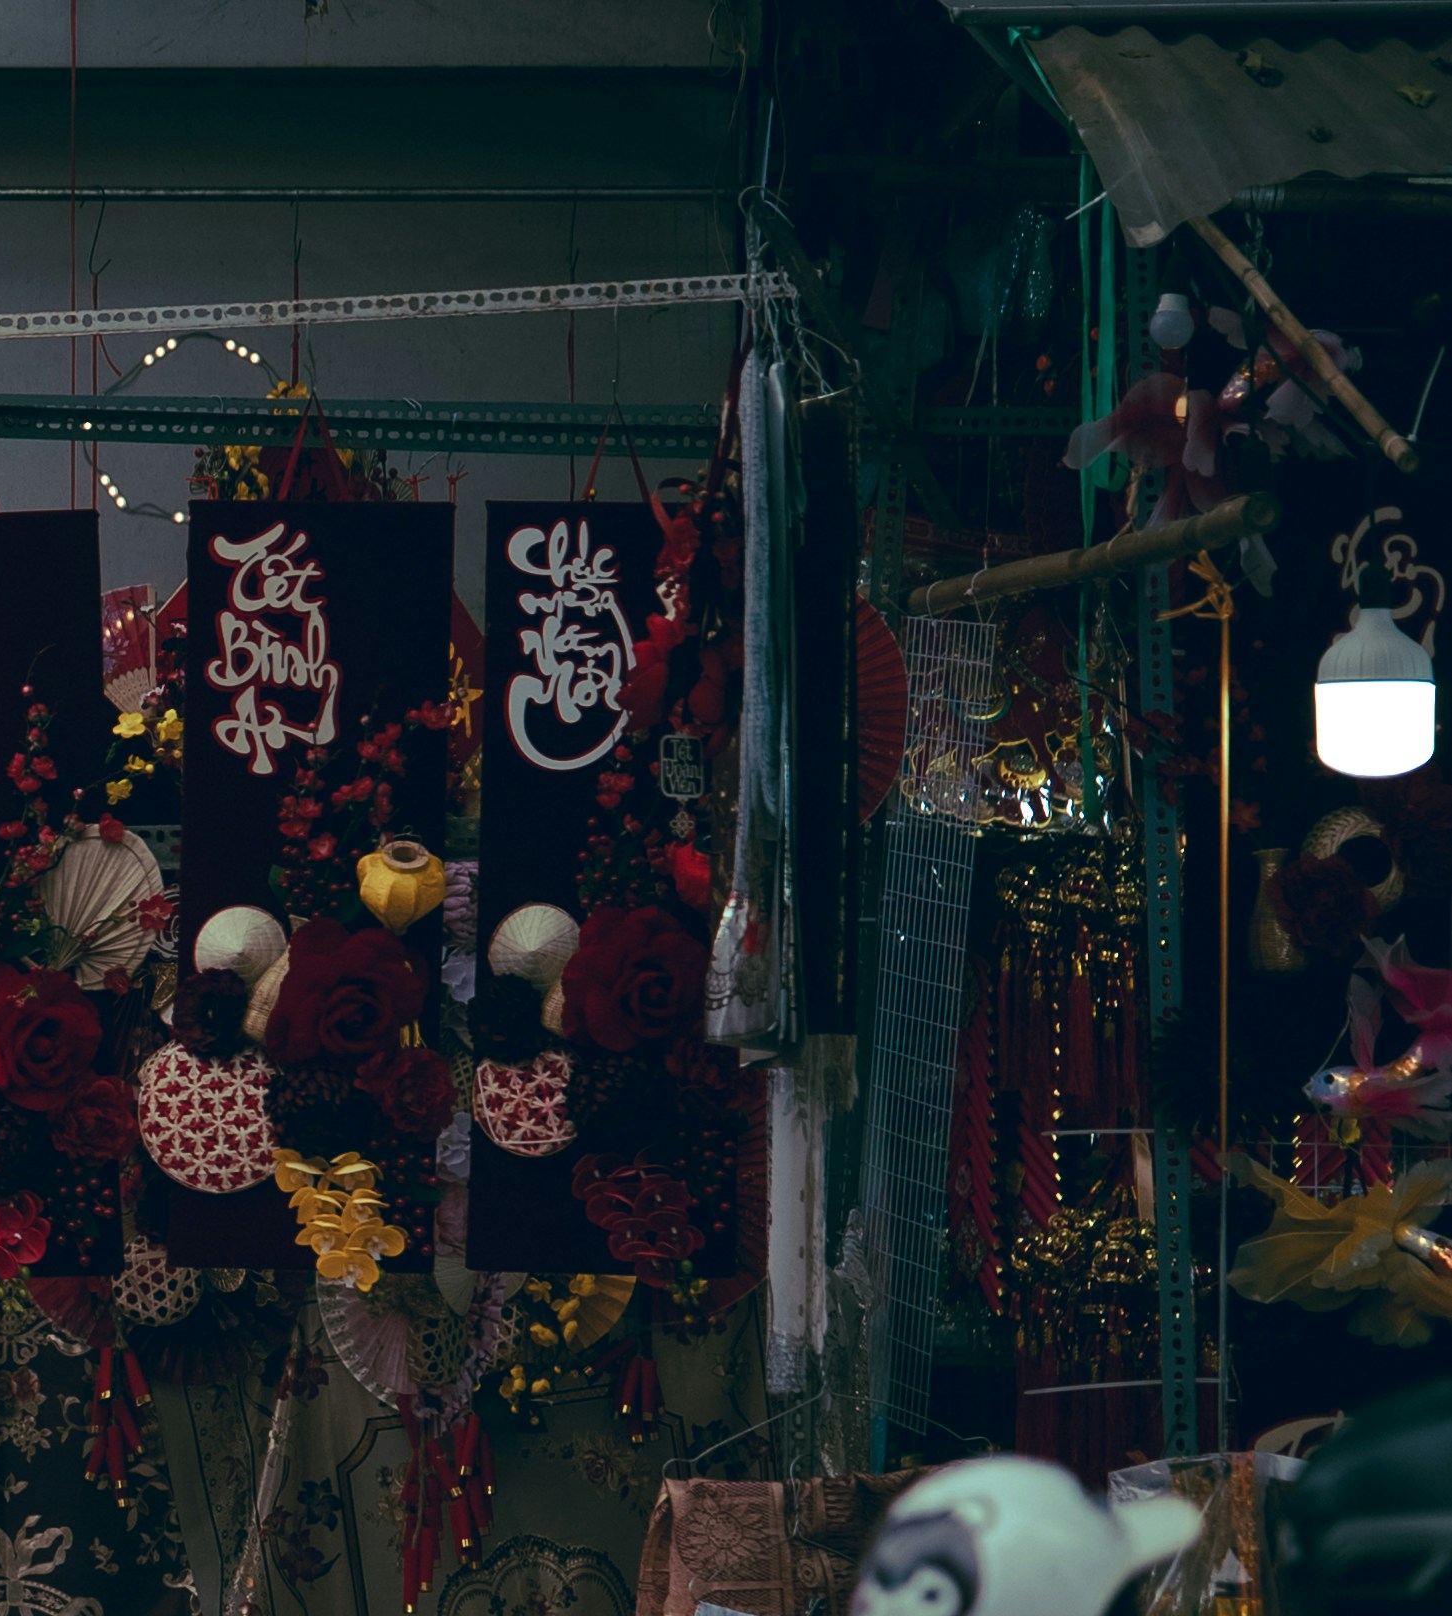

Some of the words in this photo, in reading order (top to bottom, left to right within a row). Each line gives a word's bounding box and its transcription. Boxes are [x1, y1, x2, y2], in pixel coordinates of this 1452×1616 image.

[214, 522, 323, 614] Tết
[508, 520, 619, 588] Chúc
[209, 611, 338, 690] Bình
[213, 685, 338, 775] An
